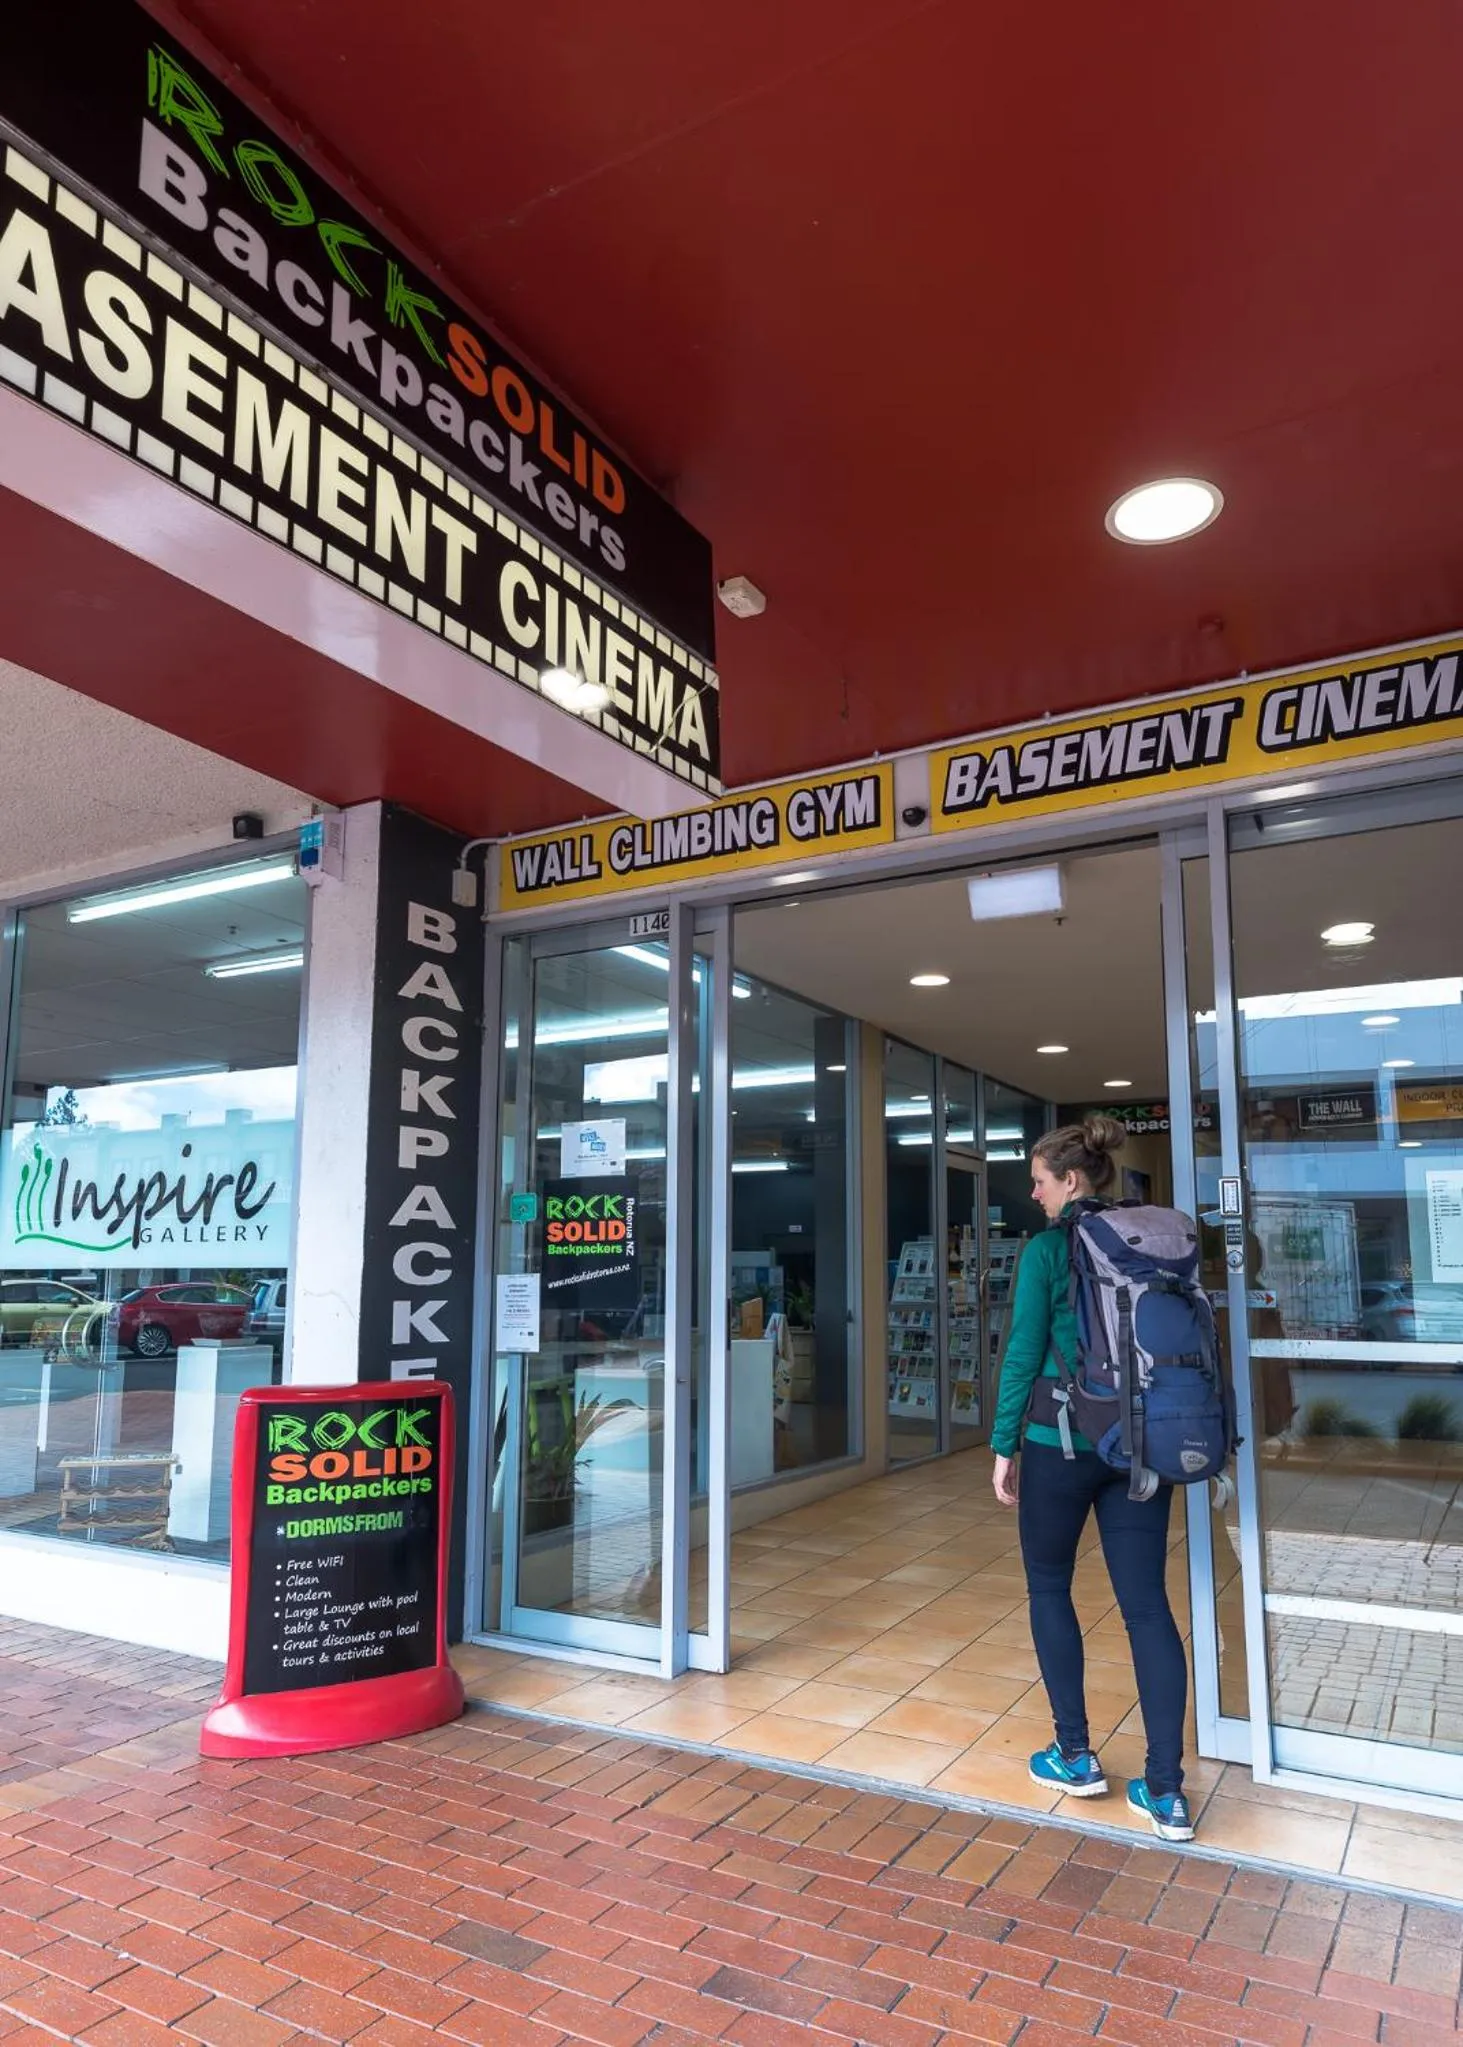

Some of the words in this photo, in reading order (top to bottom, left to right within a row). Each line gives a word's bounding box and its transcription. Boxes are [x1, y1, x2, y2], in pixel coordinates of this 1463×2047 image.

[147, 42, 446, 368] ROCK
[445, 322, 626, 515] SOLID
[138, 117, 627, 573] Backpackers
[500, 559, 711, 762] CINEMA
[944, 700, 1240, 810] BASEMENT
[1260, 656, 1463, 749] CINEM
[512, 834, 601, 891] WALL
[609, 799, 778, 873] CLIMBING
[787, 777, 879, 840] GYM
[632, 913, 670, 934] 1140
[1308, 1101, 1331, 1116] THE
[1332, 1098, 1363, 1114] WALL
[54, 1143, 276, 1250] Inspire
[546, 1194, 625, 1219] ROCK
[546, 1220, 626, 1242] SOLID
[626, 1197, 636, 1239] Rotorua
[139, 1225, 269, 1243] GALLERY
[547, 1242, 623, 1256] Backpackers
[625, 1241, 635, 1257] NZ
[268, 1408, 432, 1453] ROCK
[268, 1446, 433, 1482] SOLID
[266, 1477, 433, 1504] Backpackers
[287, 1559, 314, 1571] Free
[285, 1574, 320, 1587] Clean
[284, 1607, 319, 1620] Large
[323, 1603, 366, 1616] Lounge
[368, 1595, 394, 1609] with
[395, 1590, 419, 1610] pool
[285, 1589, 332, 1603] Modern
[283, 1621, 314, 1635] table
[318, 1620, 330, 1632] &
[333, 1617, 352, 1630] TV
[283, 1638, 319, 1651] Great
[321, 1630, 376, 1647] discounts
[378, 1628, 393, 1640] on
[396, 1620, 420, 1637] local
[282, 1654, 315, 1668] tours
[318, 1652, 330, 1664] &
[333, 1644, 385, 1662] activities
